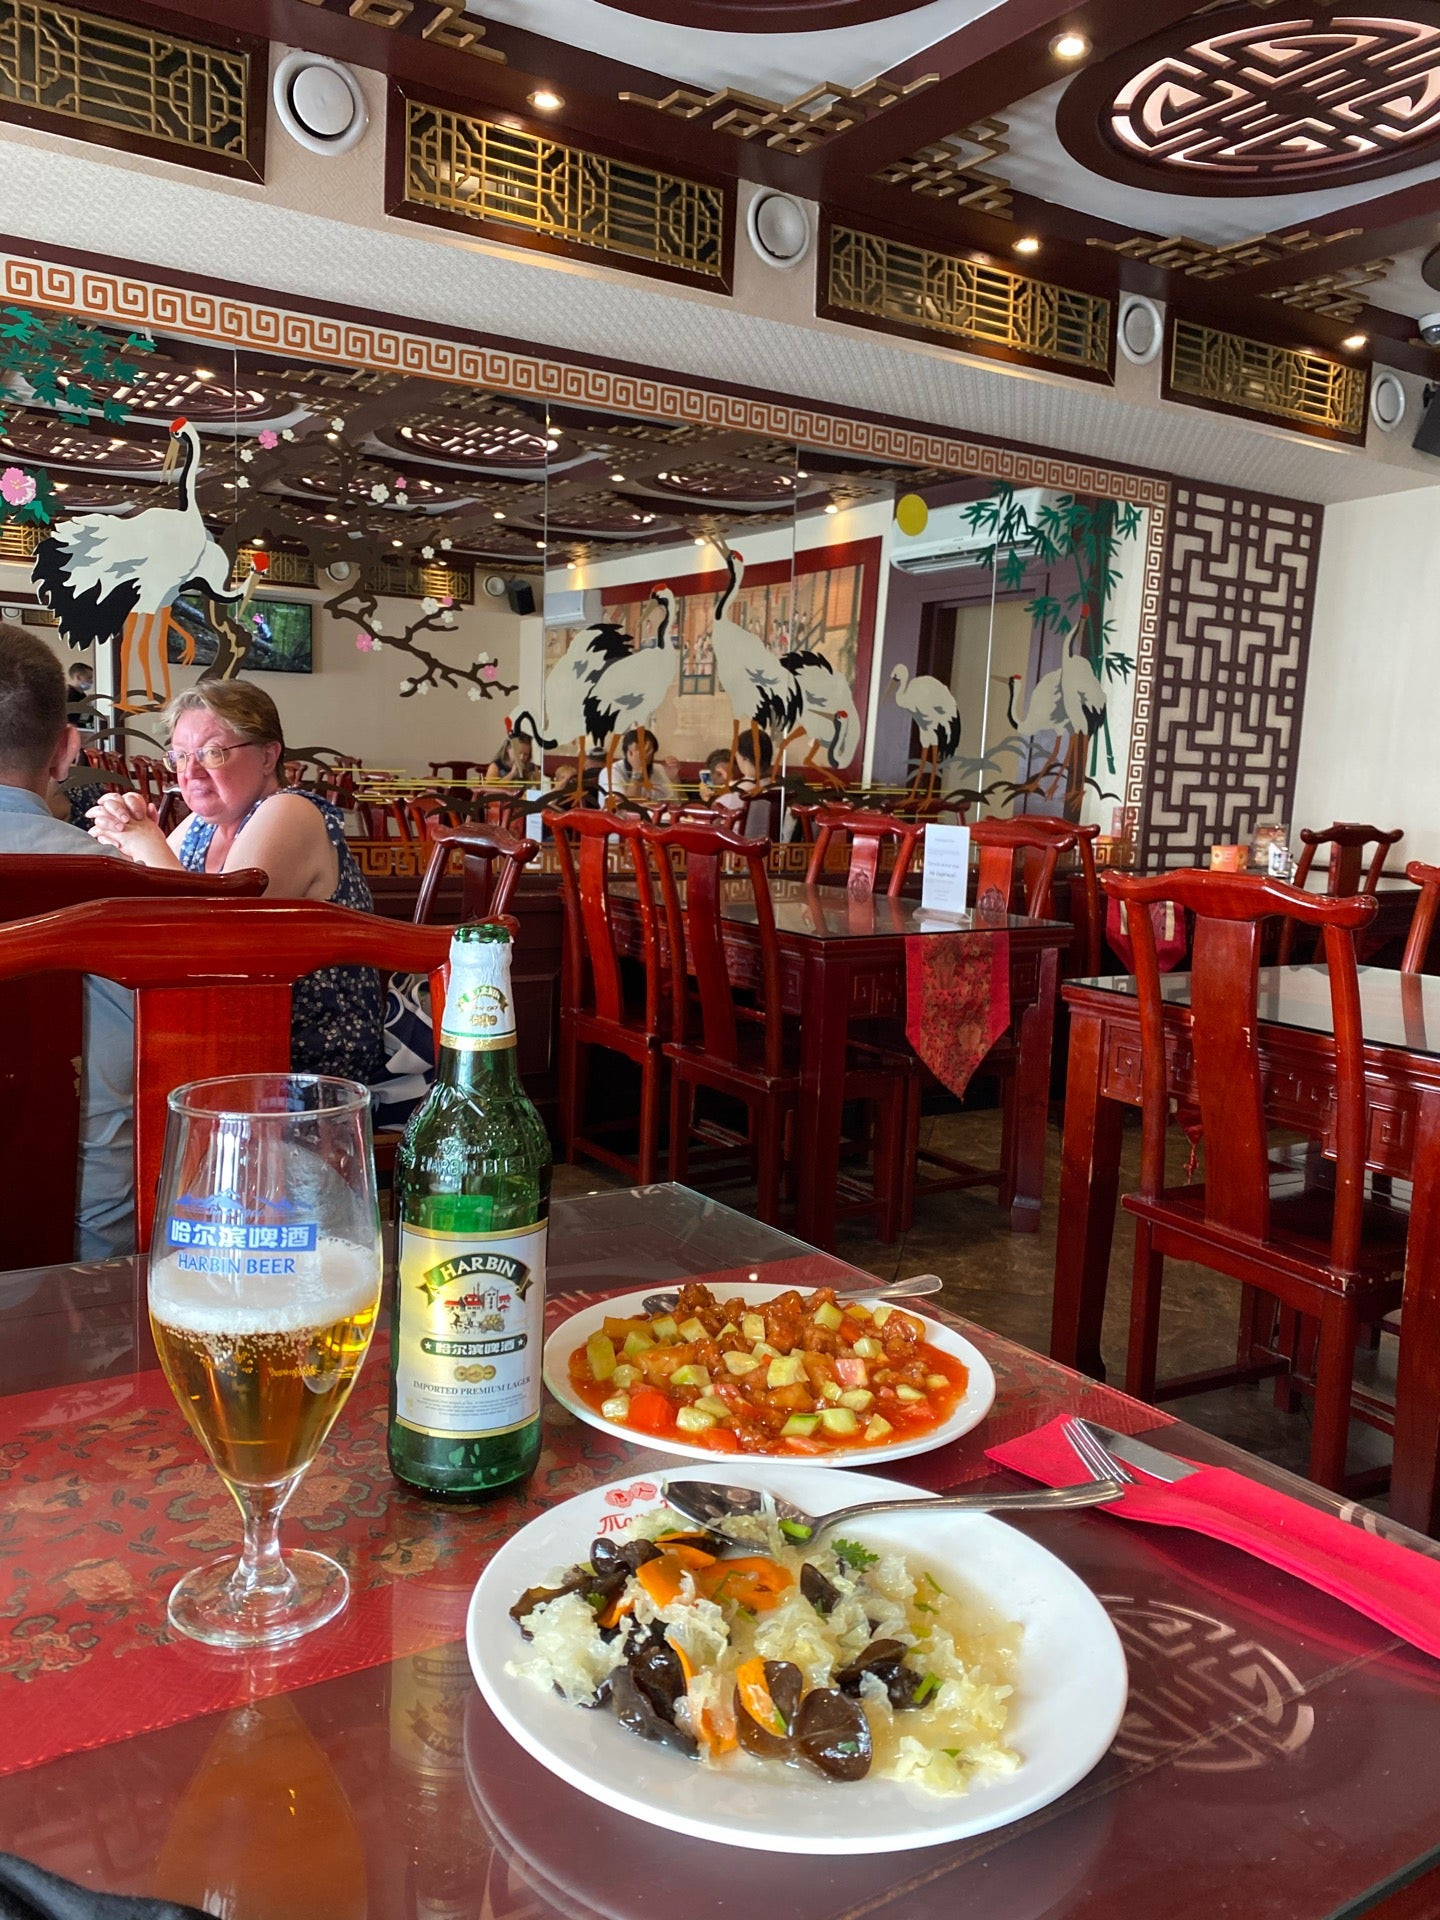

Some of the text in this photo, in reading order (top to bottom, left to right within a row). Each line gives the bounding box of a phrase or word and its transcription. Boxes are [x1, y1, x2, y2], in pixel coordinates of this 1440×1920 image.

[171, 1219, 309, 1248] 哈尔滨啤酒
[178, 1254, 296, 1274] HARBIN BEER
[441, 1255, 517, 1281] HARBIN
[413, 1376, 531, 1395] IMPORTED PREMIUM LAGER
